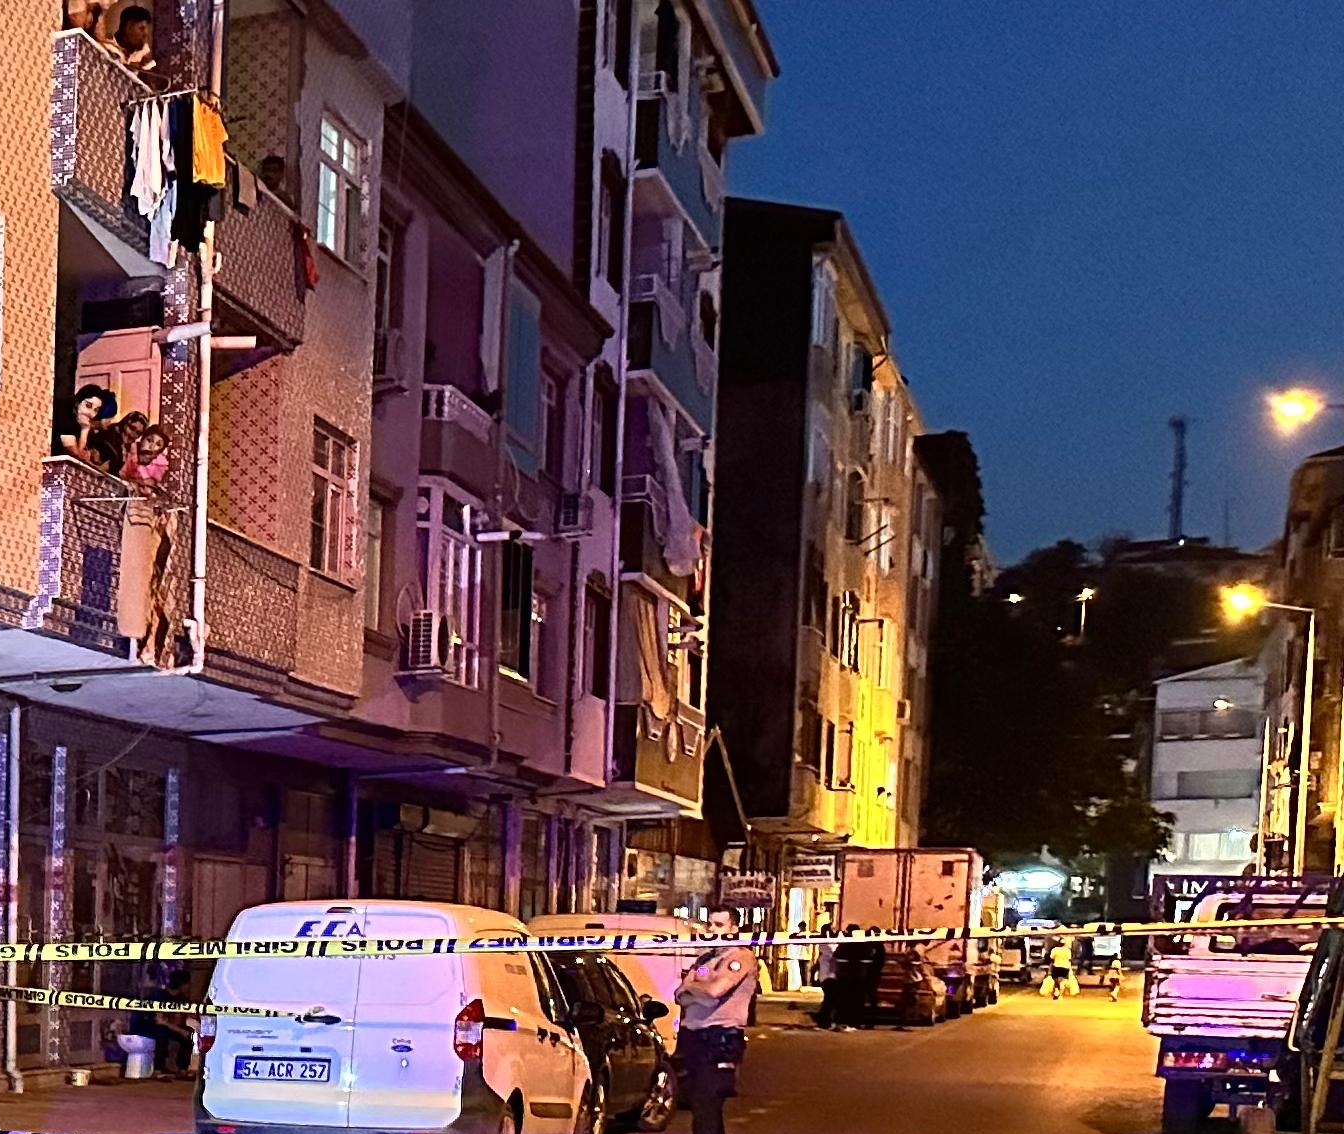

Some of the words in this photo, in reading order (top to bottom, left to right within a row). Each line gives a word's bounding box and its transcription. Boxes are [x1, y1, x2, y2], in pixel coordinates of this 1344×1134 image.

[242, 1061, 260, 1077] 54
[268, 1062, 294, 1078] ACR
[299, 1064, 327, 1079] 257
